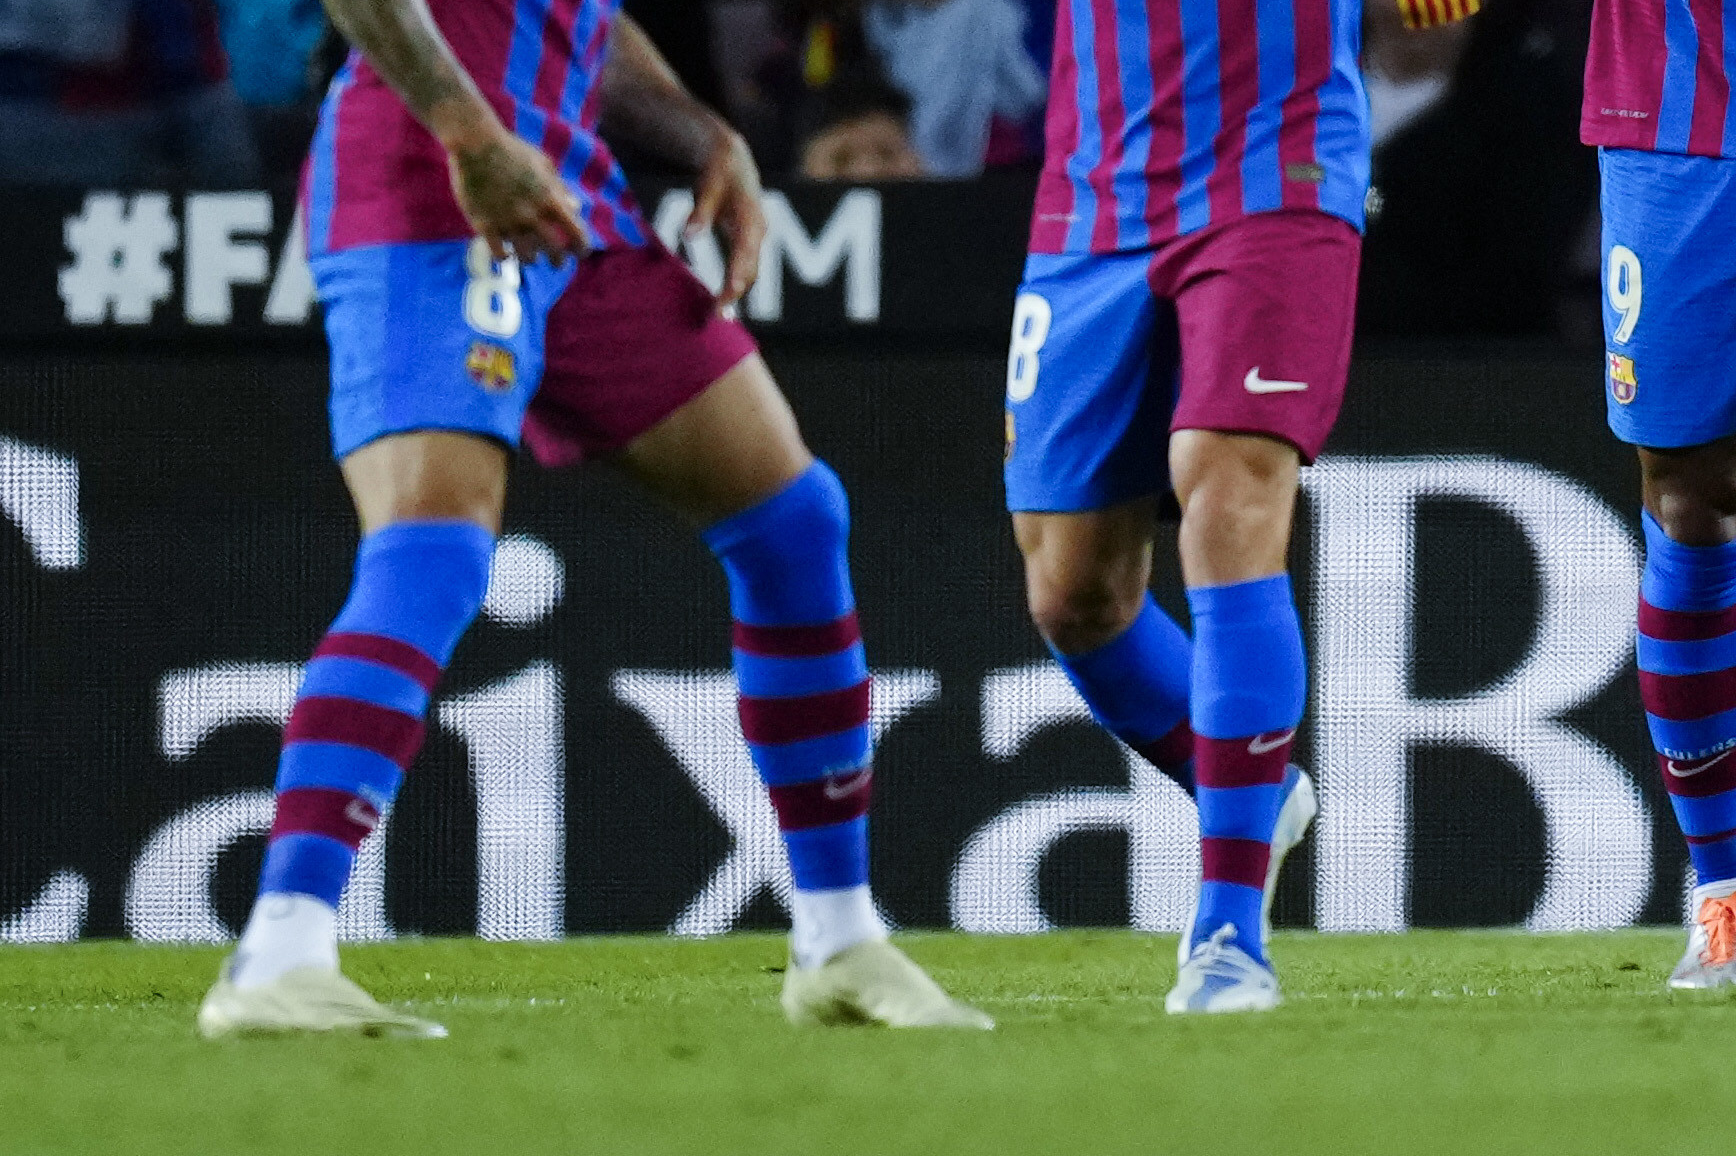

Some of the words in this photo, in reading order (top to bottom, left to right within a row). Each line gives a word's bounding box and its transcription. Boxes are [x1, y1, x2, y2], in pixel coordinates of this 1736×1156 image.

[462, 236, 523, 339] 8
[1608, 244, 1642, 345] 9
[1006, 292, 1052, 403] 8
